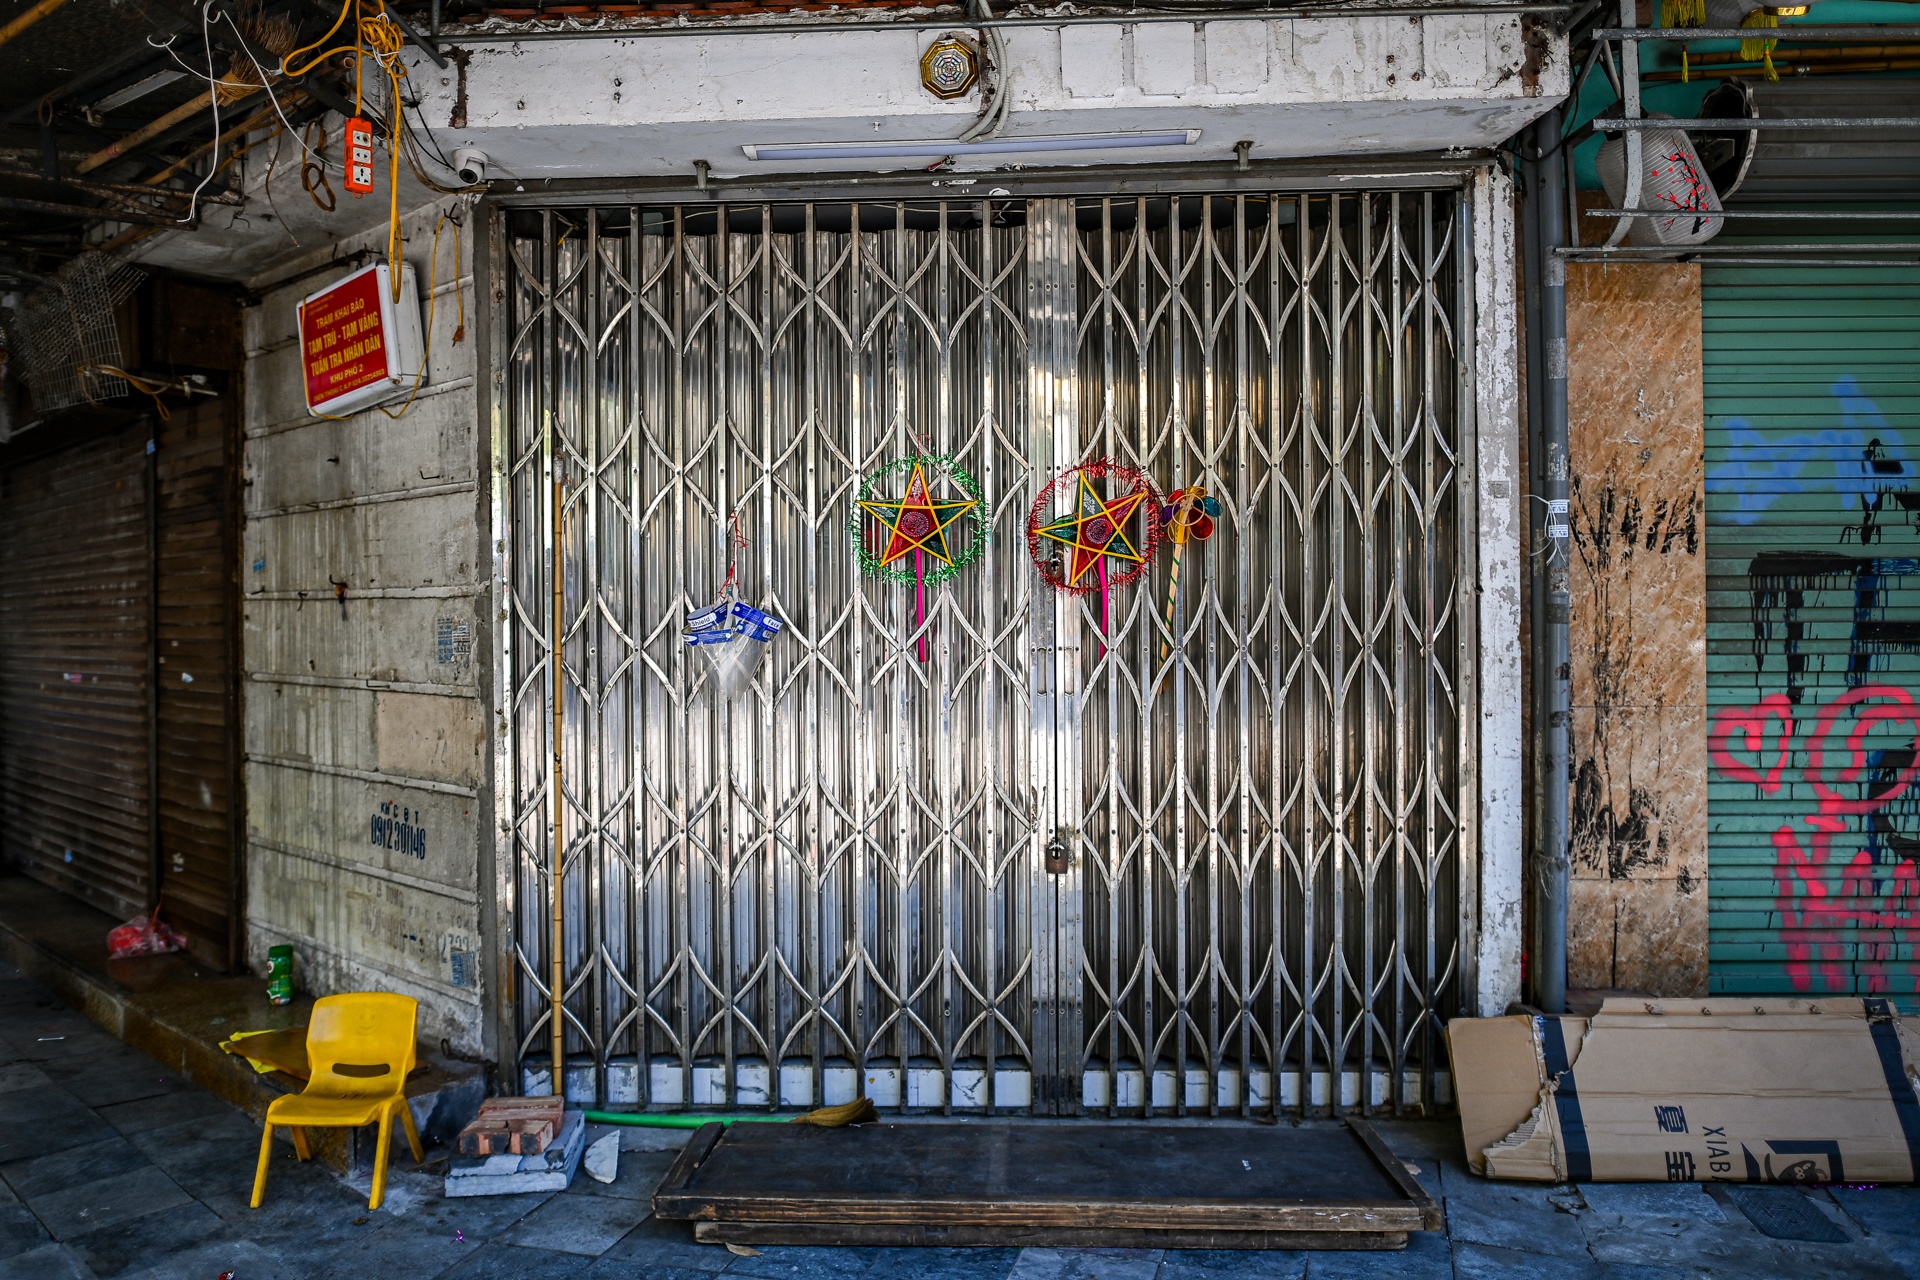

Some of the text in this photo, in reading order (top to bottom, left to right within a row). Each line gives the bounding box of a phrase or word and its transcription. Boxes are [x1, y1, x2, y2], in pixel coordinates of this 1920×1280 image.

[315, 312, 334, 329] TRẠM
[334, 305, 349, 321] KHAI
[307, 337, 322, 357] TẠM
[341, 321, 358, 341] TẠM
[329, 351, 343, 369] TRA
[330, 371, 344, 384] KHU
[358, 363, 364, 373] 2
[691, 617, 711, 627] Shield
